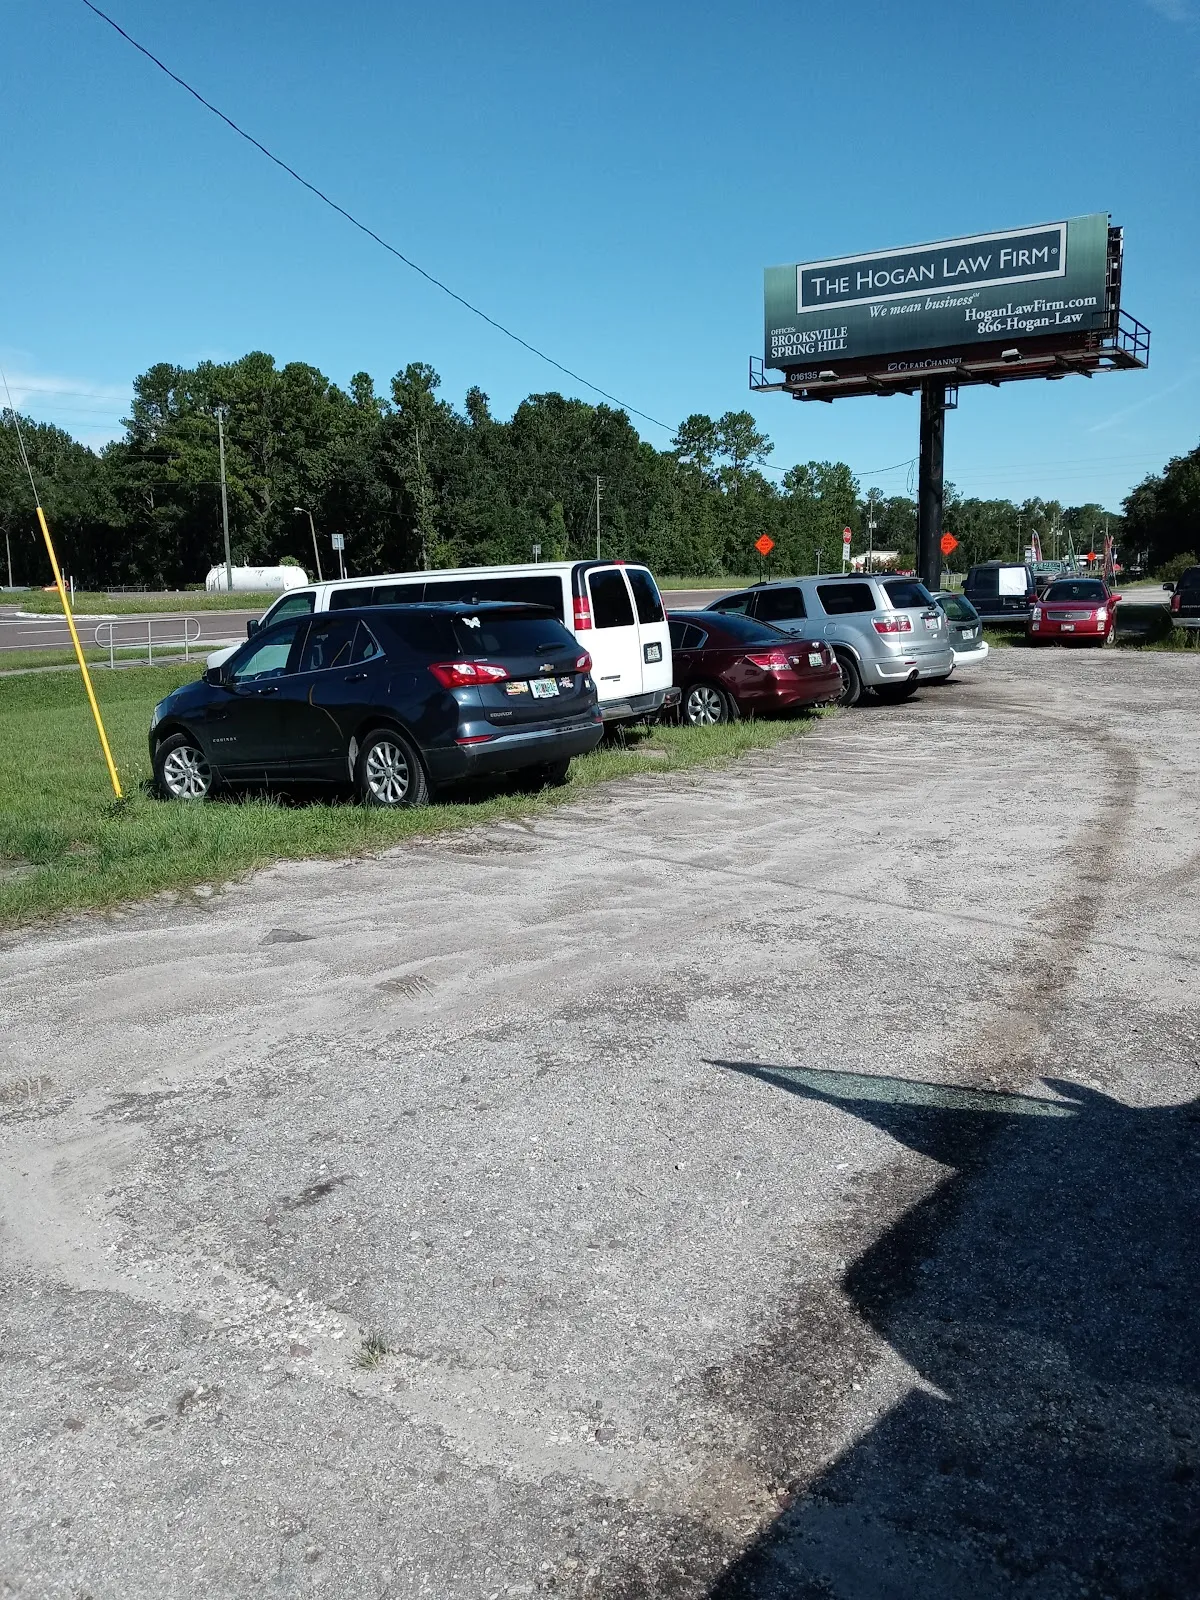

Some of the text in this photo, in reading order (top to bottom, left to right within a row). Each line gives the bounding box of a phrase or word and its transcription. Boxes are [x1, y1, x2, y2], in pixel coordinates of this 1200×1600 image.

[811, 276, 849, 296] THE
[856, 264, 935, 290] HOGAN
[943, 254, 992, 278] LAW
[869, 305, 886, 318] We
[890, 303, 921, 315] mean
[964, 296, 1097, 322] HoganLawFirm.com
[977, 312, 1084, 334] 866-Hogan-Law
[771, 326, 848, 347] BROOKSVILLE
[771, 338, 848, 358] SPRING HILL
[790, 371, 818, 381] 016135
